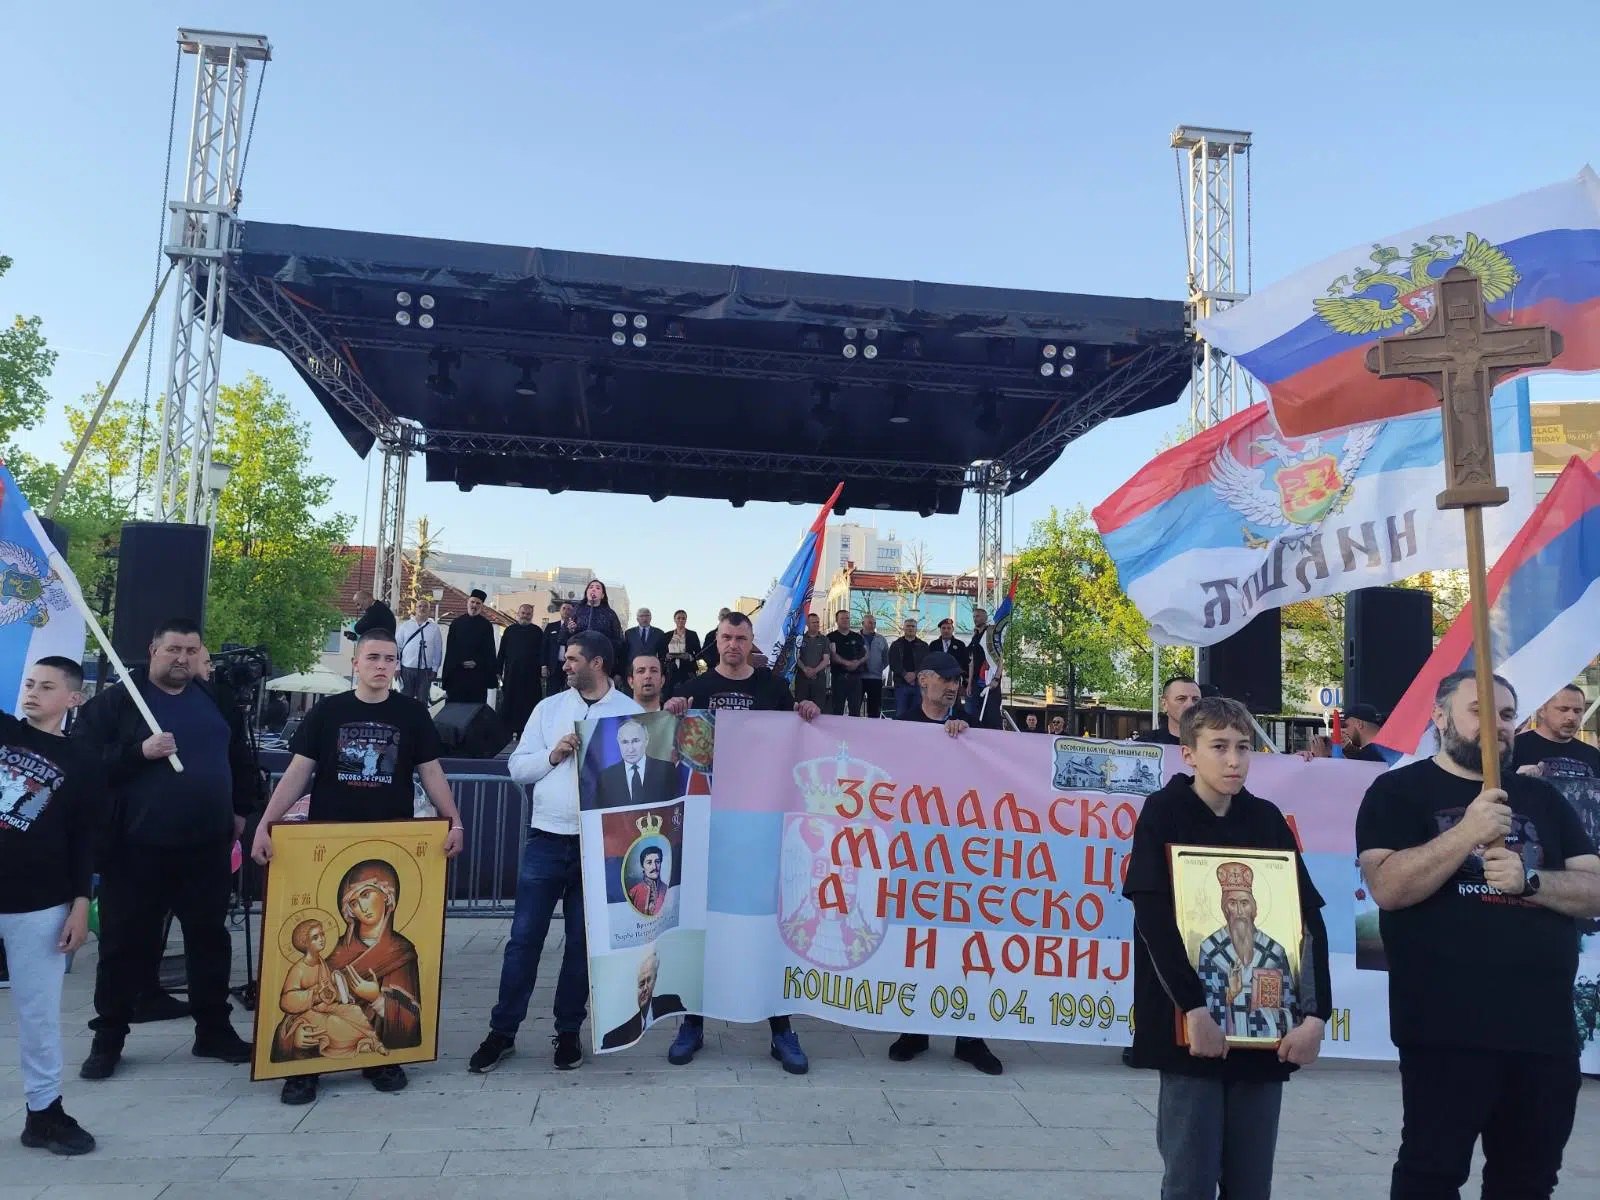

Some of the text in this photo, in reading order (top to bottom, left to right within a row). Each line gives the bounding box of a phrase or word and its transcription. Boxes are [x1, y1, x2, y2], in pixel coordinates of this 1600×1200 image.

[835, 778, 1137, 841] ЗЕМАЉСКО
[830, 826, 1057, 883] МАЛЕНА
[818, 873, 1105, 932] А НЕБЕСКО
[905, 927, 937, 969] И
[783, 966, 918, 1017] КОШАРЕ
[930, 985, 976, 1021] 09.
[989, 988, 1035, 1024] 04.
